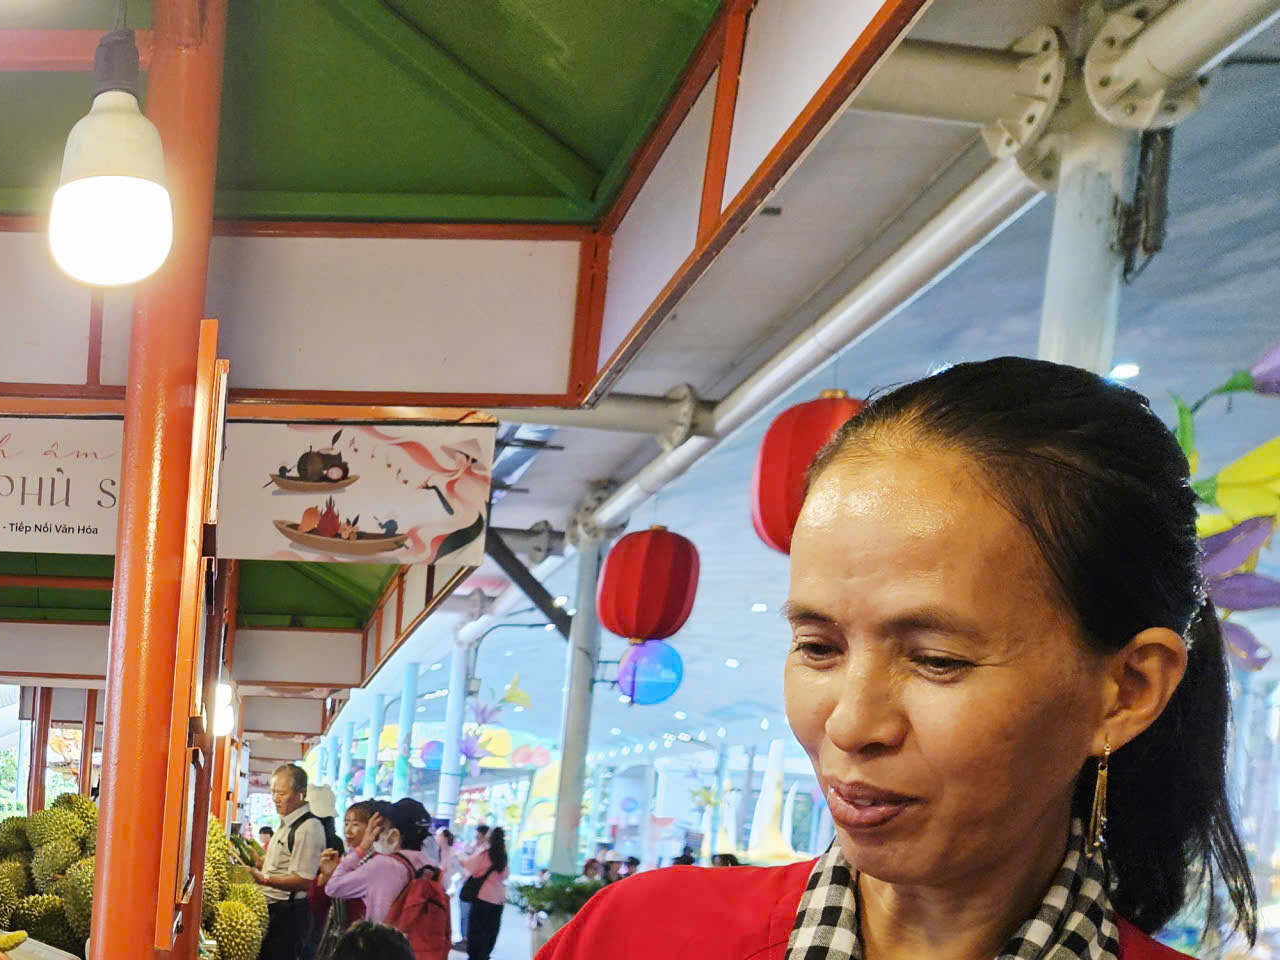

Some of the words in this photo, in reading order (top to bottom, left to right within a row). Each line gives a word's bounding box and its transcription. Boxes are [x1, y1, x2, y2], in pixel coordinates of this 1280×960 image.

[43, 441, 117, 460] âm
[97, 478, 118, 508] S
[9, 521, 32, 534] Tiếp
[34, 521, 52, 534] Nối
[55, 523, 75, 534] Văn
[77, 524, 99, 535] Hóa
